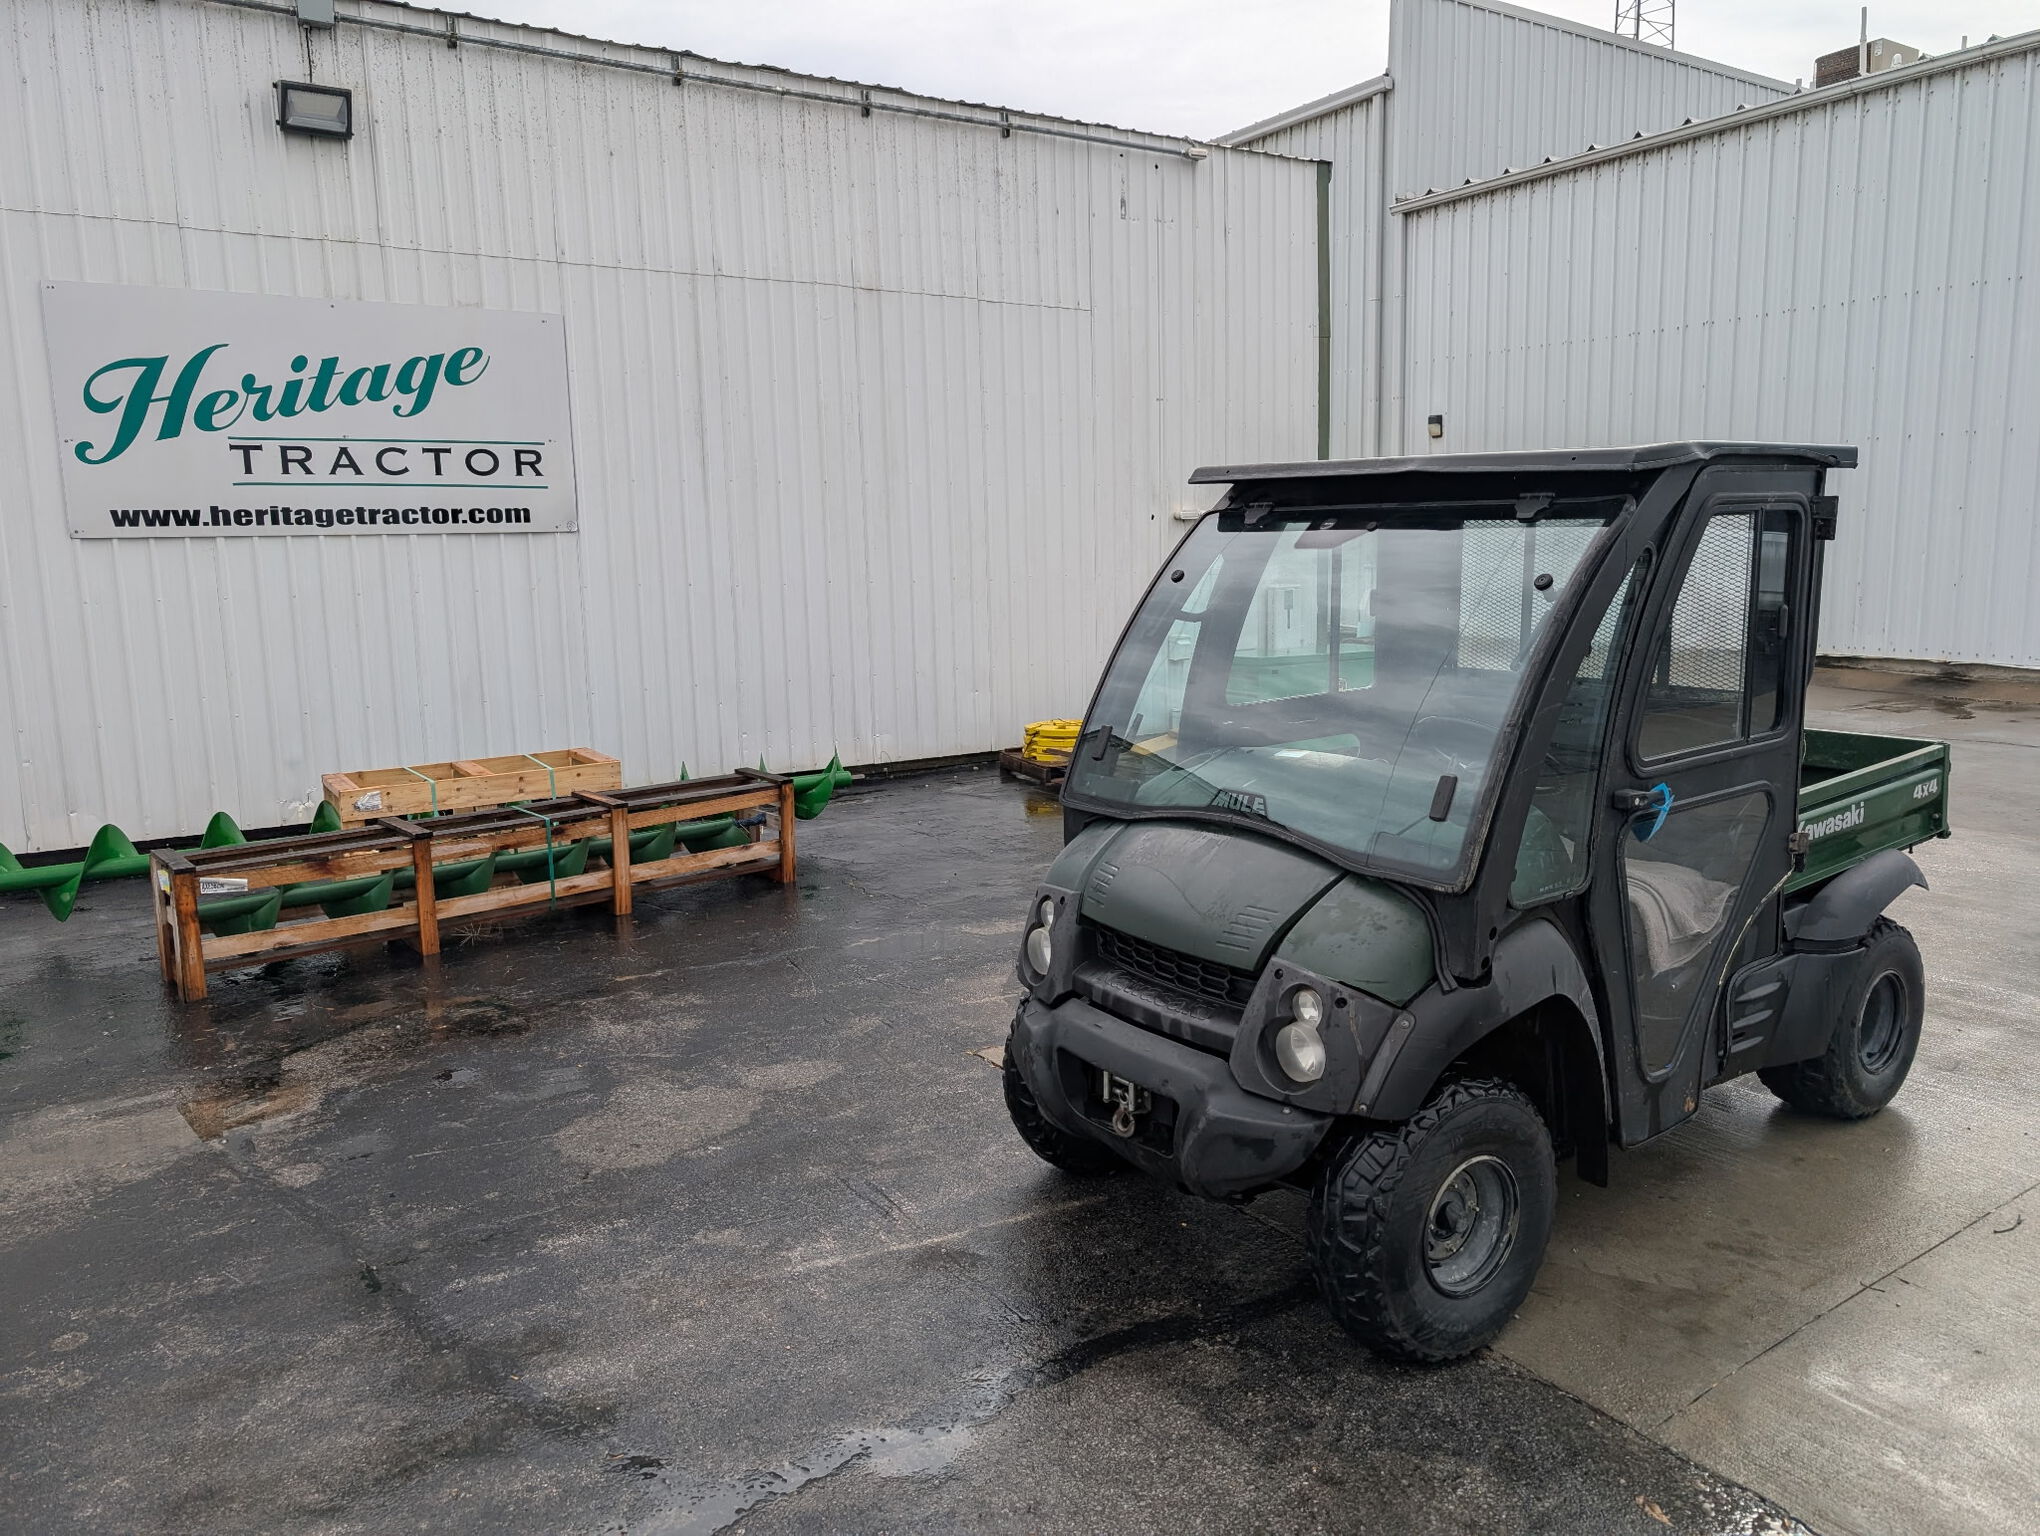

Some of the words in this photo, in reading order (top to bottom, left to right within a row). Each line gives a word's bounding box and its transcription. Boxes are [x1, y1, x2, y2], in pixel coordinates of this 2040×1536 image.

[74, 343, 491, 465] Heritage
[228, 443, 545, 477] TRACTOR
[109, 504, 532, 529] www.heritagetractor.com
[1210, 788, 1267, 816] MULE
[1912, 778, 1939, 800] 4x4
